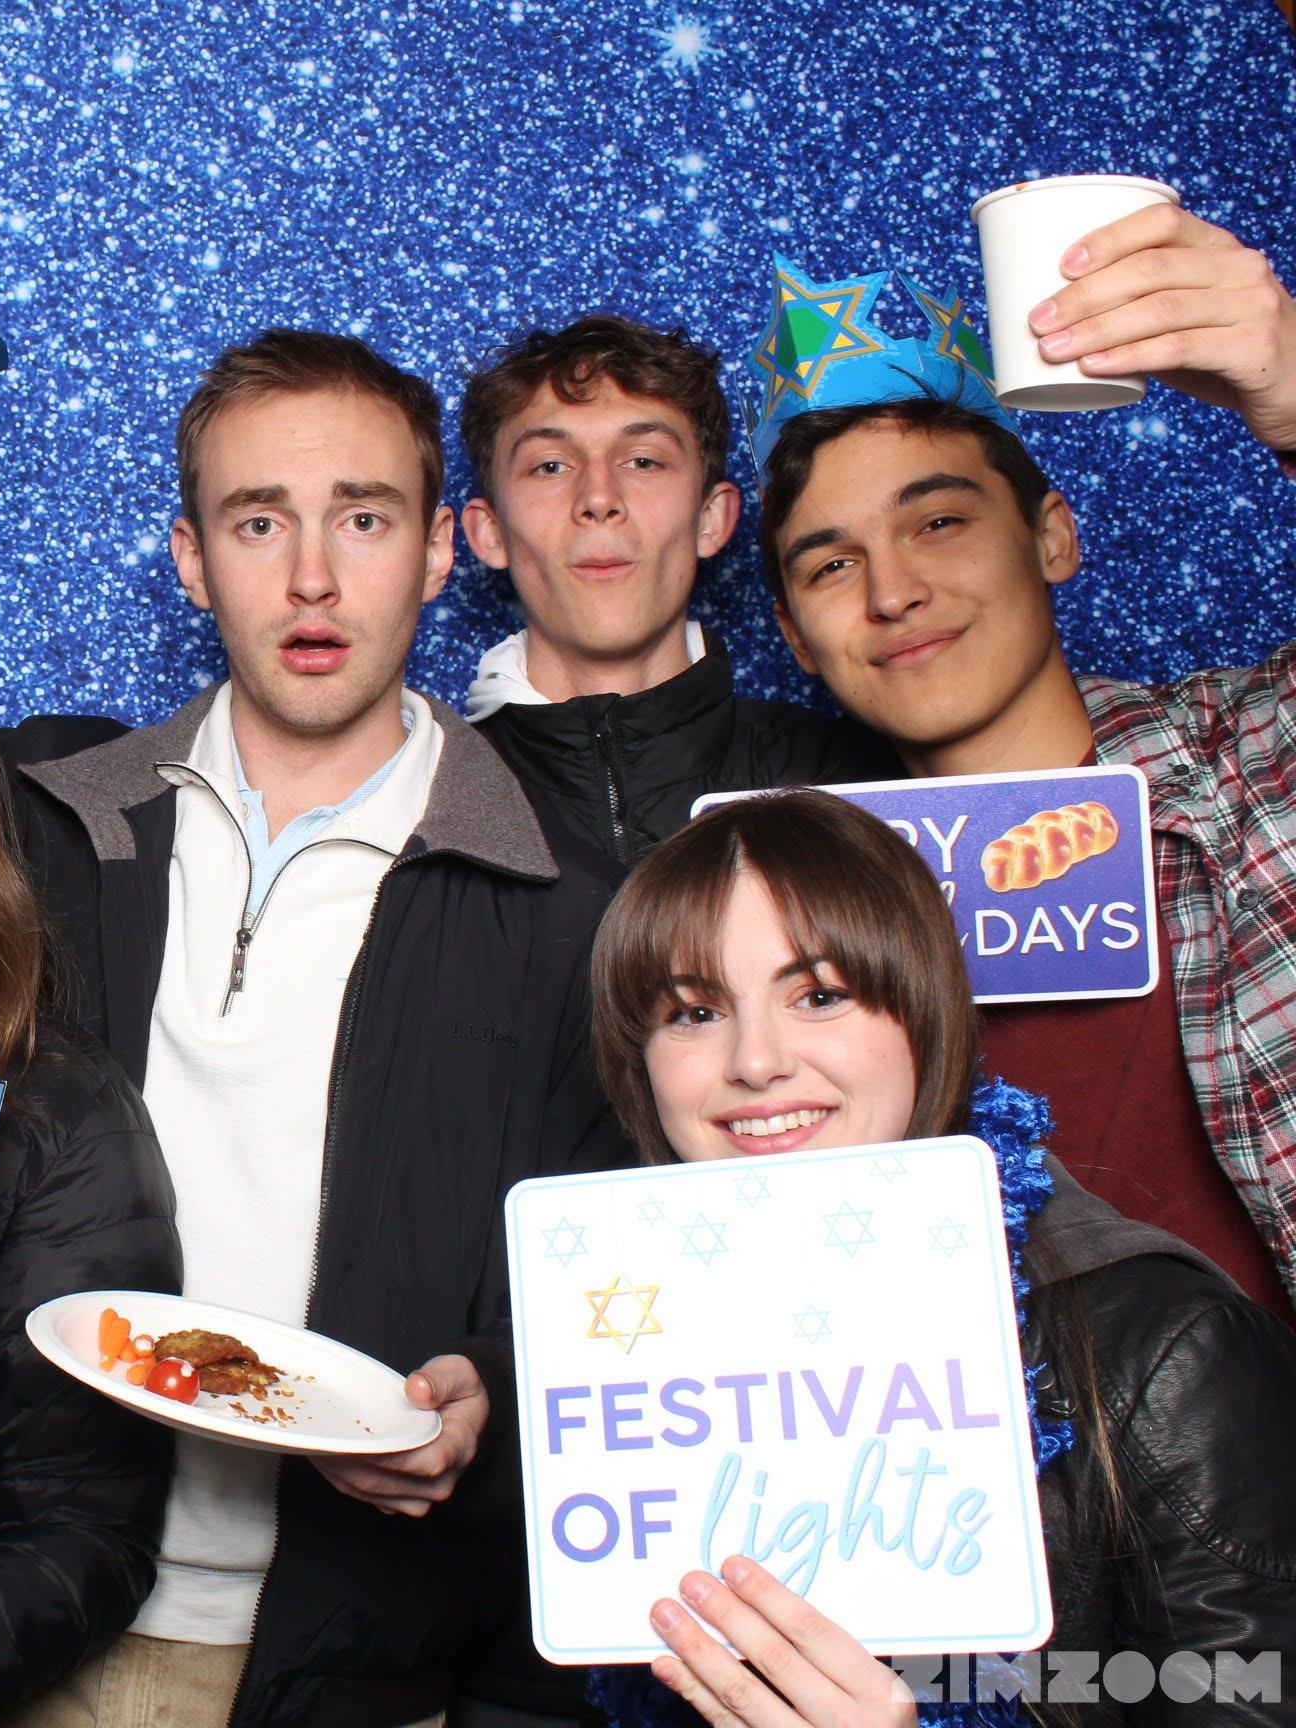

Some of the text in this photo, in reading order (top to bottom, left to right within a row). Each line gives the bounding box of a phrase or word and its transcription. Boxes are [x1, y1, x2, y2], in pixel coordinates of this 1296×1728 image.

[544, 1358, 1001, 1455] FESTIVAL
[551, 1437, 993, 1600] OF lights
